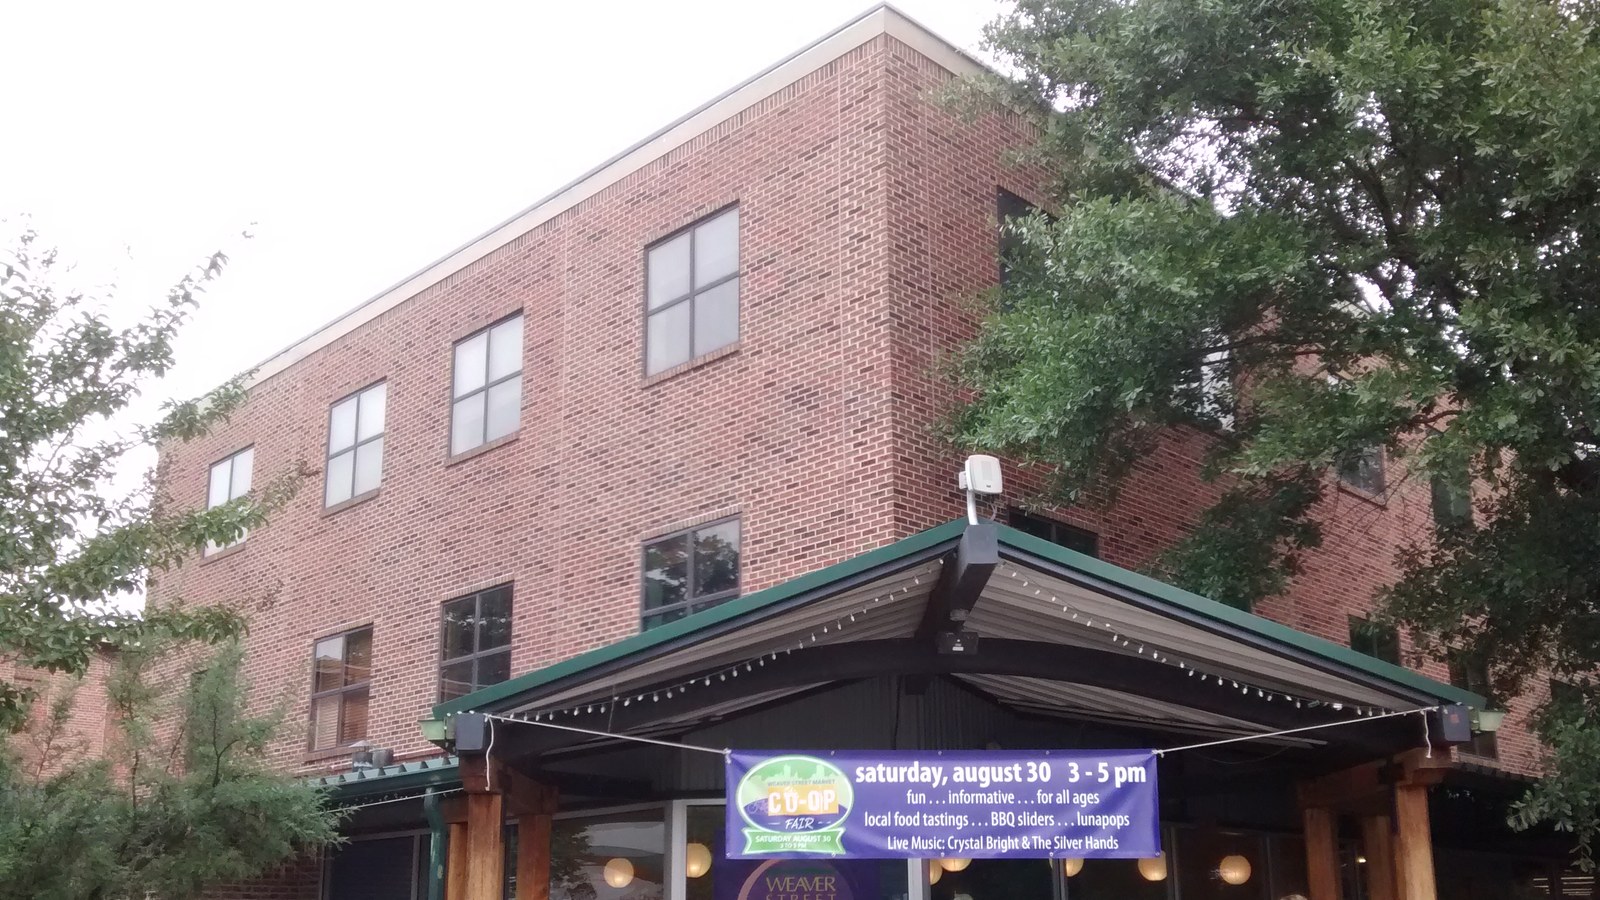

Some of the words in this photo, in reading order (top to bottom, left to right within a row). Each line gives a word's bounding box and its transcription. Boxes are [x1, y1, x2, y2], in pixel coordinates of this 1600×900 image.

[855, 761, 948, 788] saturday,
[952, 763, 1022, 788] august
[1026, 761, 1051, 783] 30
[1068, 762, 1080, 783] 3
[1097, 762, 1109, 783] 5
[1114, 766, 1146, 788] pm
[768, 788, 836, 814] CO-OP
[906, 789, 926, 805] fun
[948, 789, 1015, 805] informative
[1036, 789, 1054, 805] for
[1055, 789, 1070, 805] all
[1072, 792, 1100, 808] ages
[785, 817, 815, 830] FAIR
[864, 811, 891, 827] local
[894, 811, 920, 827] food
[922, 812, 969, 830] tastings
[991, 811, 1016, 828] BBQ
[1017, 811, 1055, 827] sliders
[1076, 811, 1130, 830] lunapops
[755, 834, 791, 843] SATURDAY
[792, 834, 821, 843] AUGUST
[887, 835, 909, 850] Live
[911, 835, 945, 850] Music:
[947, 836, 983, 853] Crystal
[986, 835, 1020, 853] Bright
[1021, 836, 1031, 850] &
[1032, 836, 1052, 850] The
[1053, 835, 1083, 850] Silver
[1085, 836, 1119, 850] Hands
[766, 876, 836, 892] WEAVER
